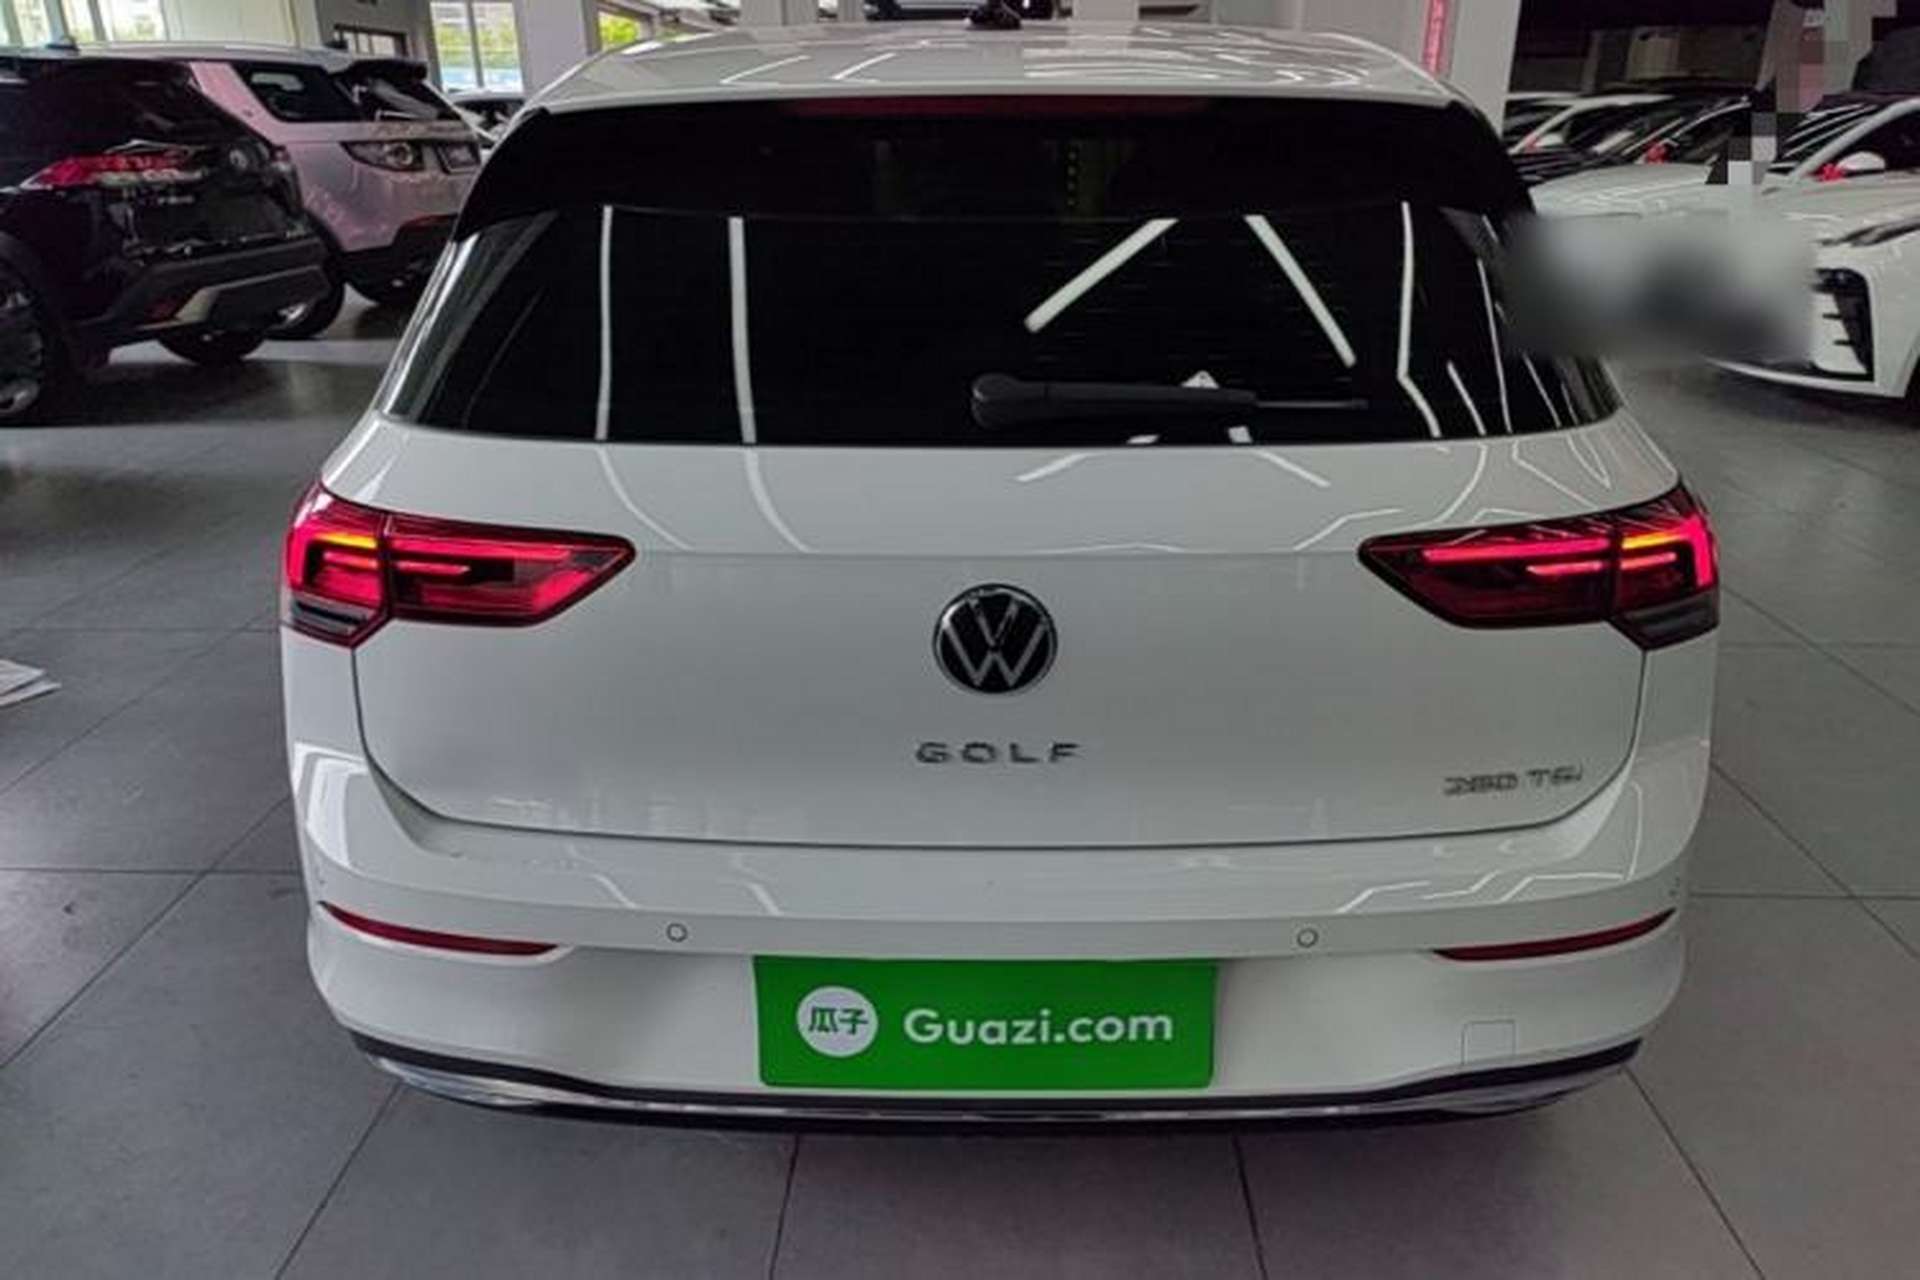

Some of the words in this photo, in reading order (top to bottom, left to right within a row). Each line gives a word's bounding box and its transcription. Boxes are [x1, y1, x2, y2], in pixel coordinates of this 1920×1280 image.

[915, 741, 1082, 764] GOLF
[807, 1006, 869, 1035] 瓜子
[903, 1008, 1173, 1045] Guazi.com
